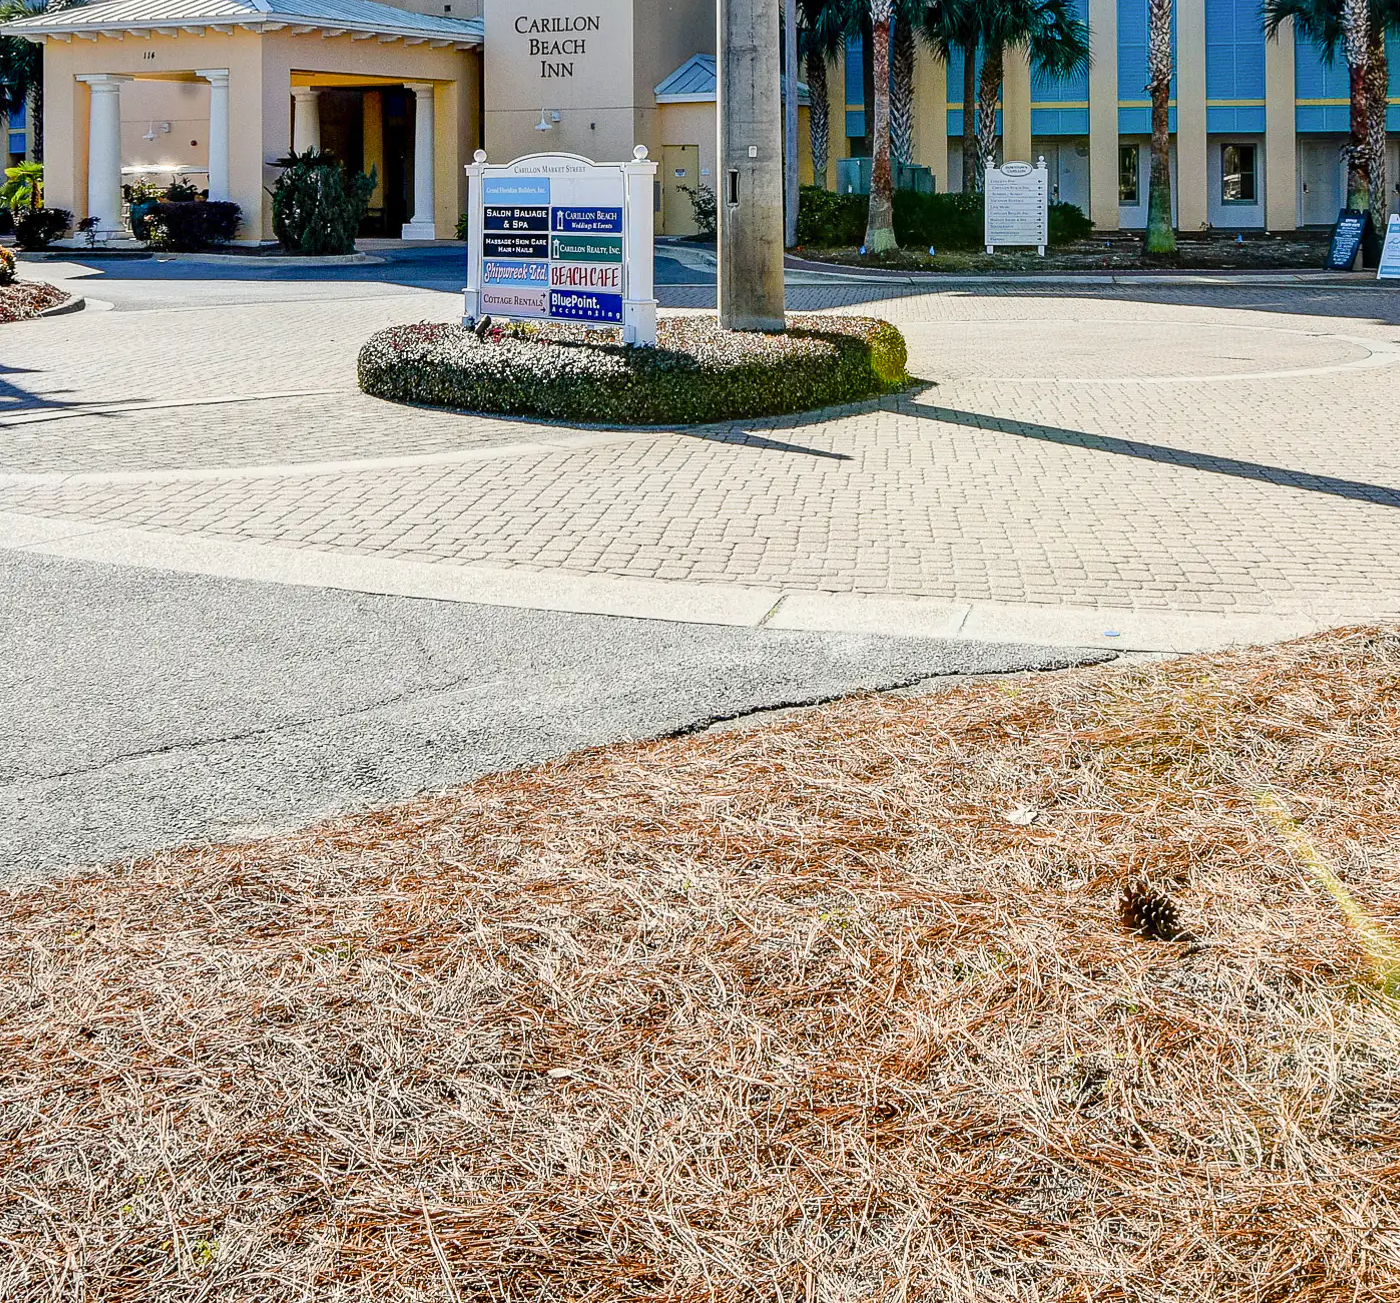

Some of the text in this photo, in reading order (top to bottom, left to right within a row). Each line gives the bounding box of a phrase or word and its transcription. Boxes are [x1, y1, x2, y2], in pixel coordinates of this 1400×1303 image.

[514, 16, 600, 34] CARILLON
[529, 38, 586, 56] BEACH
[540, 60, 574, 78] INN
[513, 164, 586, 174] CARILLON MARKET STREET
[486, 209, 512, 218] SALON
[565, 210, 618, 221] CARILLON BEACH
[503, 220, 529, 229] & SPA
[571, 222, 593, 230] Weddings
[560, 244, 621, 255] CARILLON REALTY, INC.
[484, 262, 548, 283] Shipwreck Ltd.
[551, 265, 619, 288] BEACH CAFE
[483, 293, 543, 307] COTTAGE RENTALS
[551, 293, 600, 309] BluePoint.
[551, 306, 620, 320] Accounting
